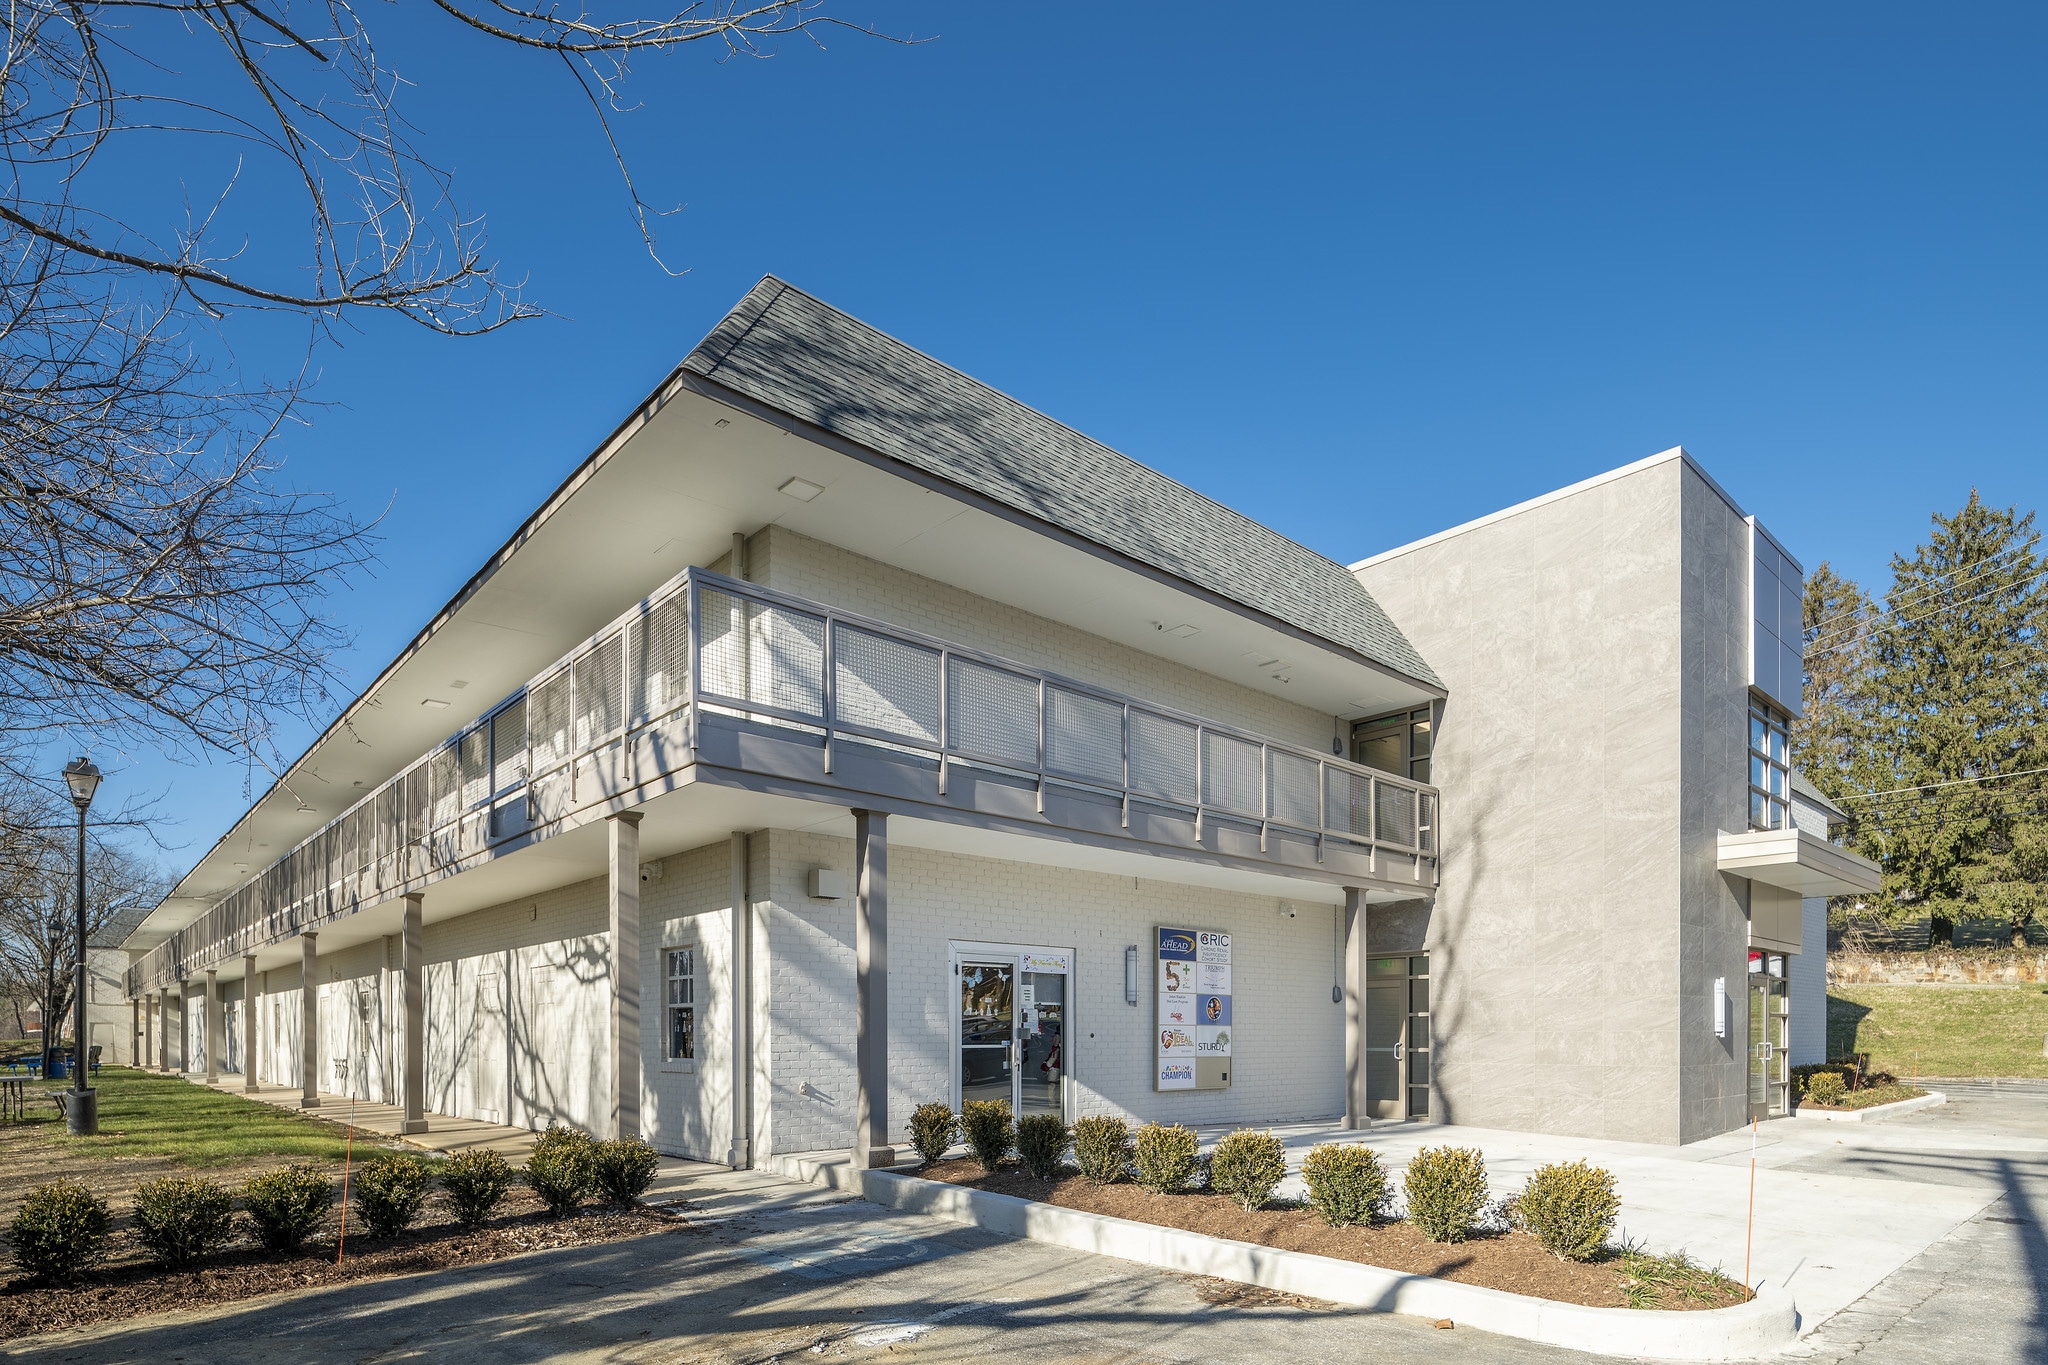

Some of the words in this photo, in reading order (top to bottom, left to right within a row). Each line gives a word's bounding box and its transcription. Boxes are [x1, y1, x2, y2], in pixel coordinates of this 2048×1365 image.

[1200, 933, 1229, 947] CRIC
[1160, 941, 1188, 949] AHEAD
[1198, 1042, 1225, 1052] STURDY
[1162, 1071, 1192, 1080] CHAMPION
